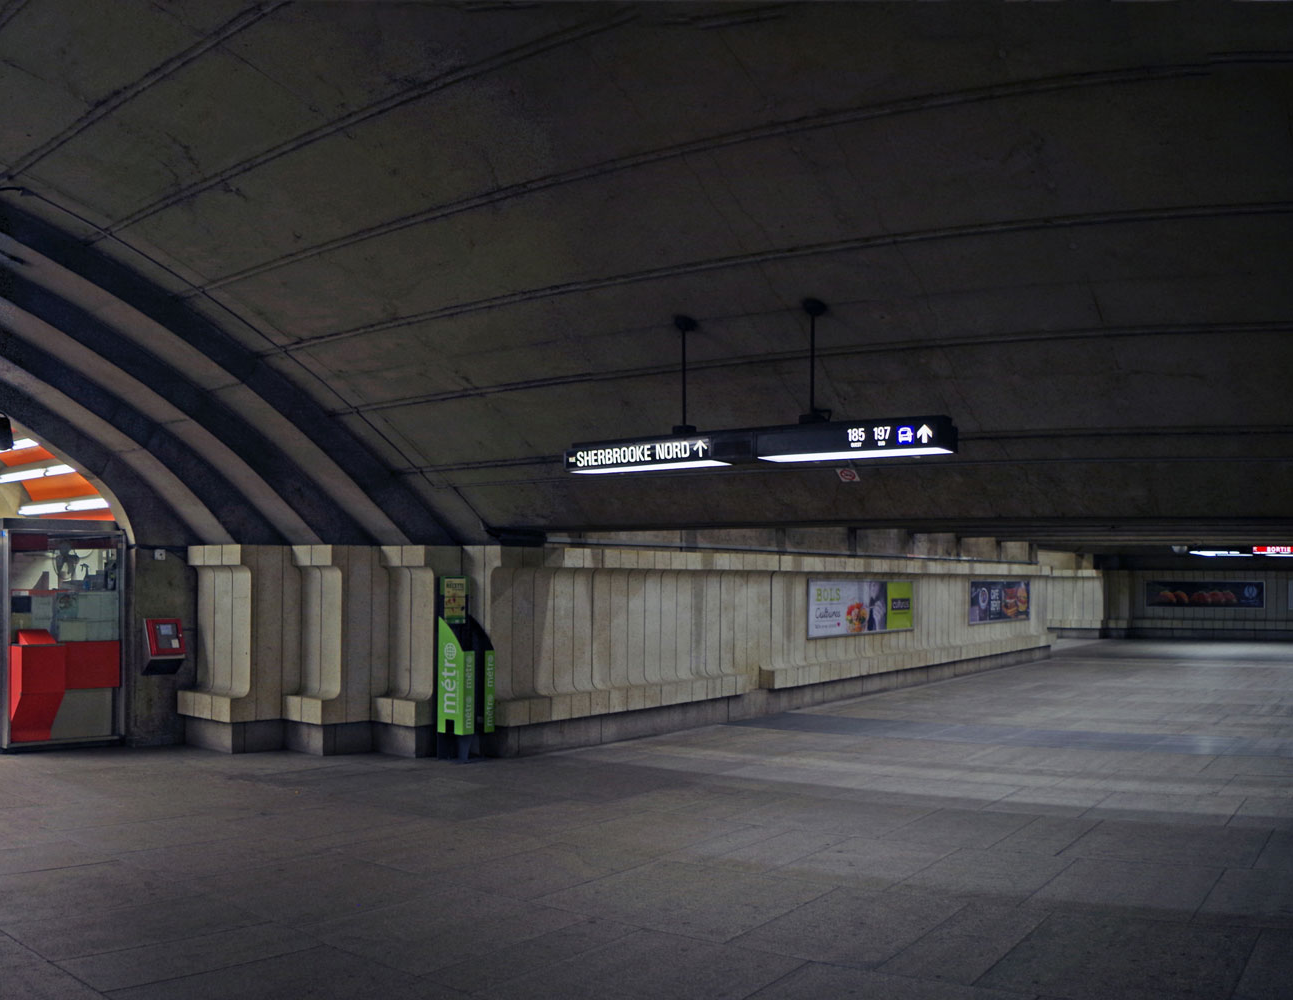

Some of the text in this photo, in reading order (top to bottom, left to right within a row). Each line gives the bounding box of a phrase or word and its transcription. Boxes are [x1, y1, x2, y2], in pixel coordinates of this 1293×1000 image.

[847, 426, 891, 441] 185 197
[576, 441, 690, 467] SHERBROOKE NORD
[816, 587, 841, 602] BOLS
[440, 642, 457, 714] métro
